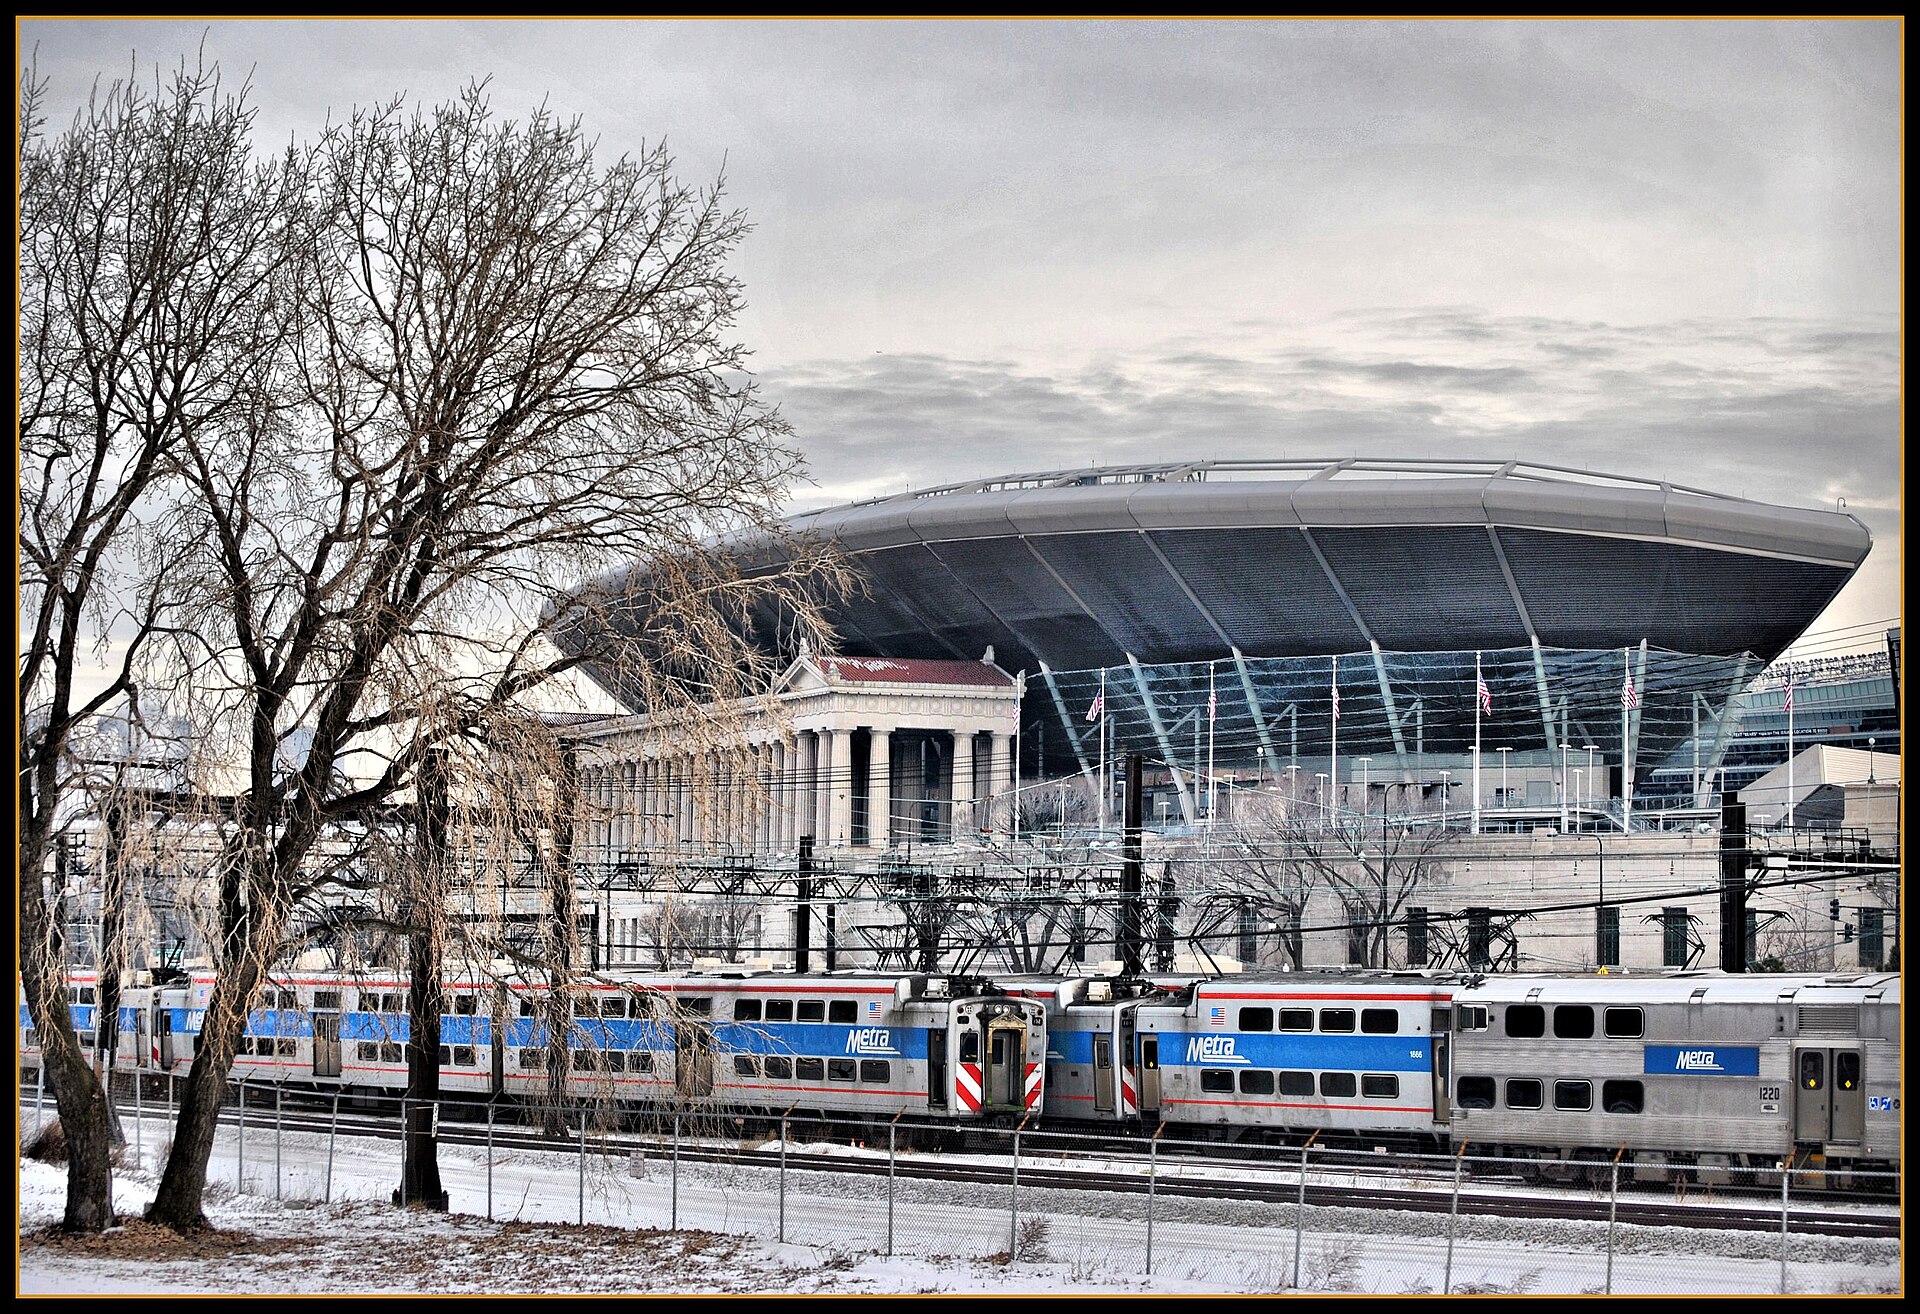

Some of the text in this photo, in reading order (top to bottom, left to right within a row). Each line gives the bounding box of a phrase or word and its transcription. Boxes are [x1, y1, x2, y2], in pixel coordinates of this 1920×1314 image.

[845, 1026, 891, 1054] Metra
[1186, 1034, 1236, 1063] Metra
[1675, 1050, 1716, 1070] Metra
[1759, 1087, 1780, 1100] 1220
